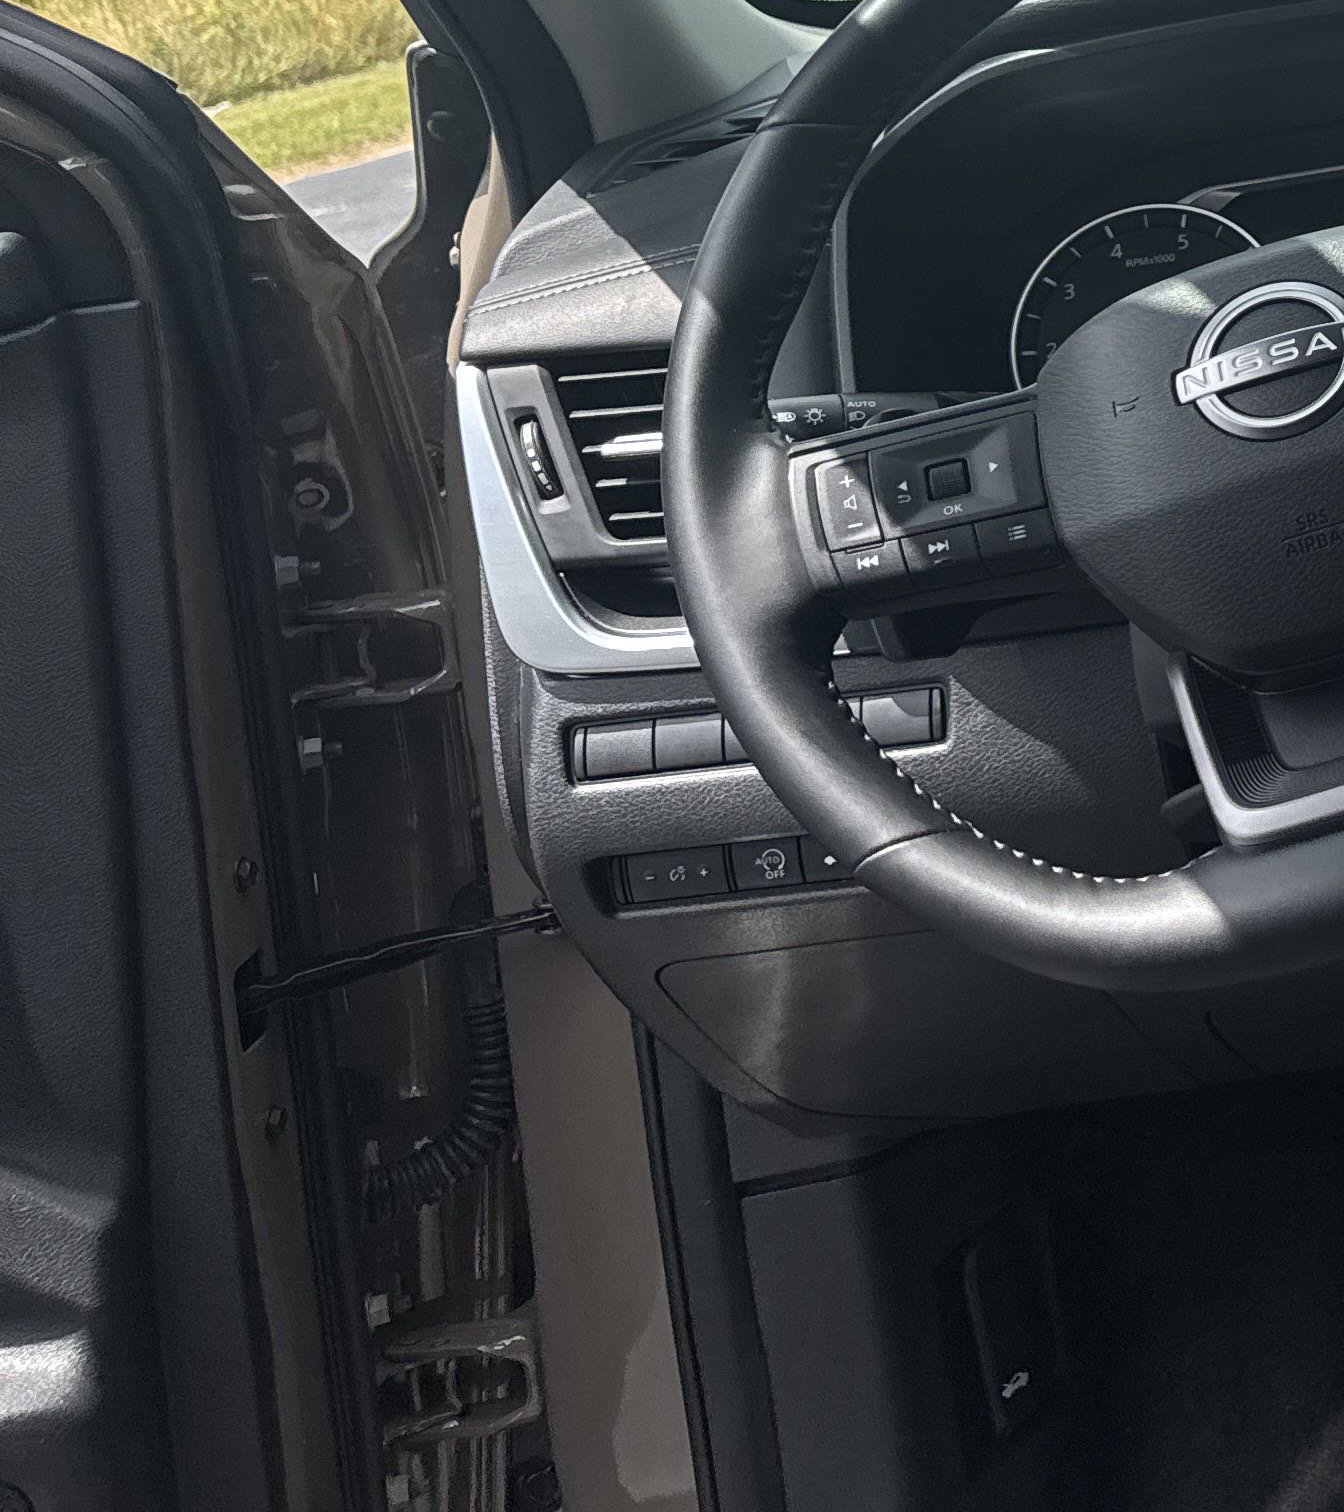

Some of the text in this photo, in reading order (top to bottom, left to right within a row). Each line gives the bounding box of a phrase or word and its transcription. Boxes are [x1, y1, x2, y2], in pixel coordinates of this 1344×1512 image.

[1177, 234, 1189, 250] 5
[1110, 243, 1123, 259] 4
[1063, 284, 1075, 300] 3
[847, 400, 877, 408] AUTO
[943, 503, 964, 516] OK
[1296, 508, 1329, 530] SRS
[755, 856, 781, 865] AUTO
[765, 869, 786, 880] OFF
